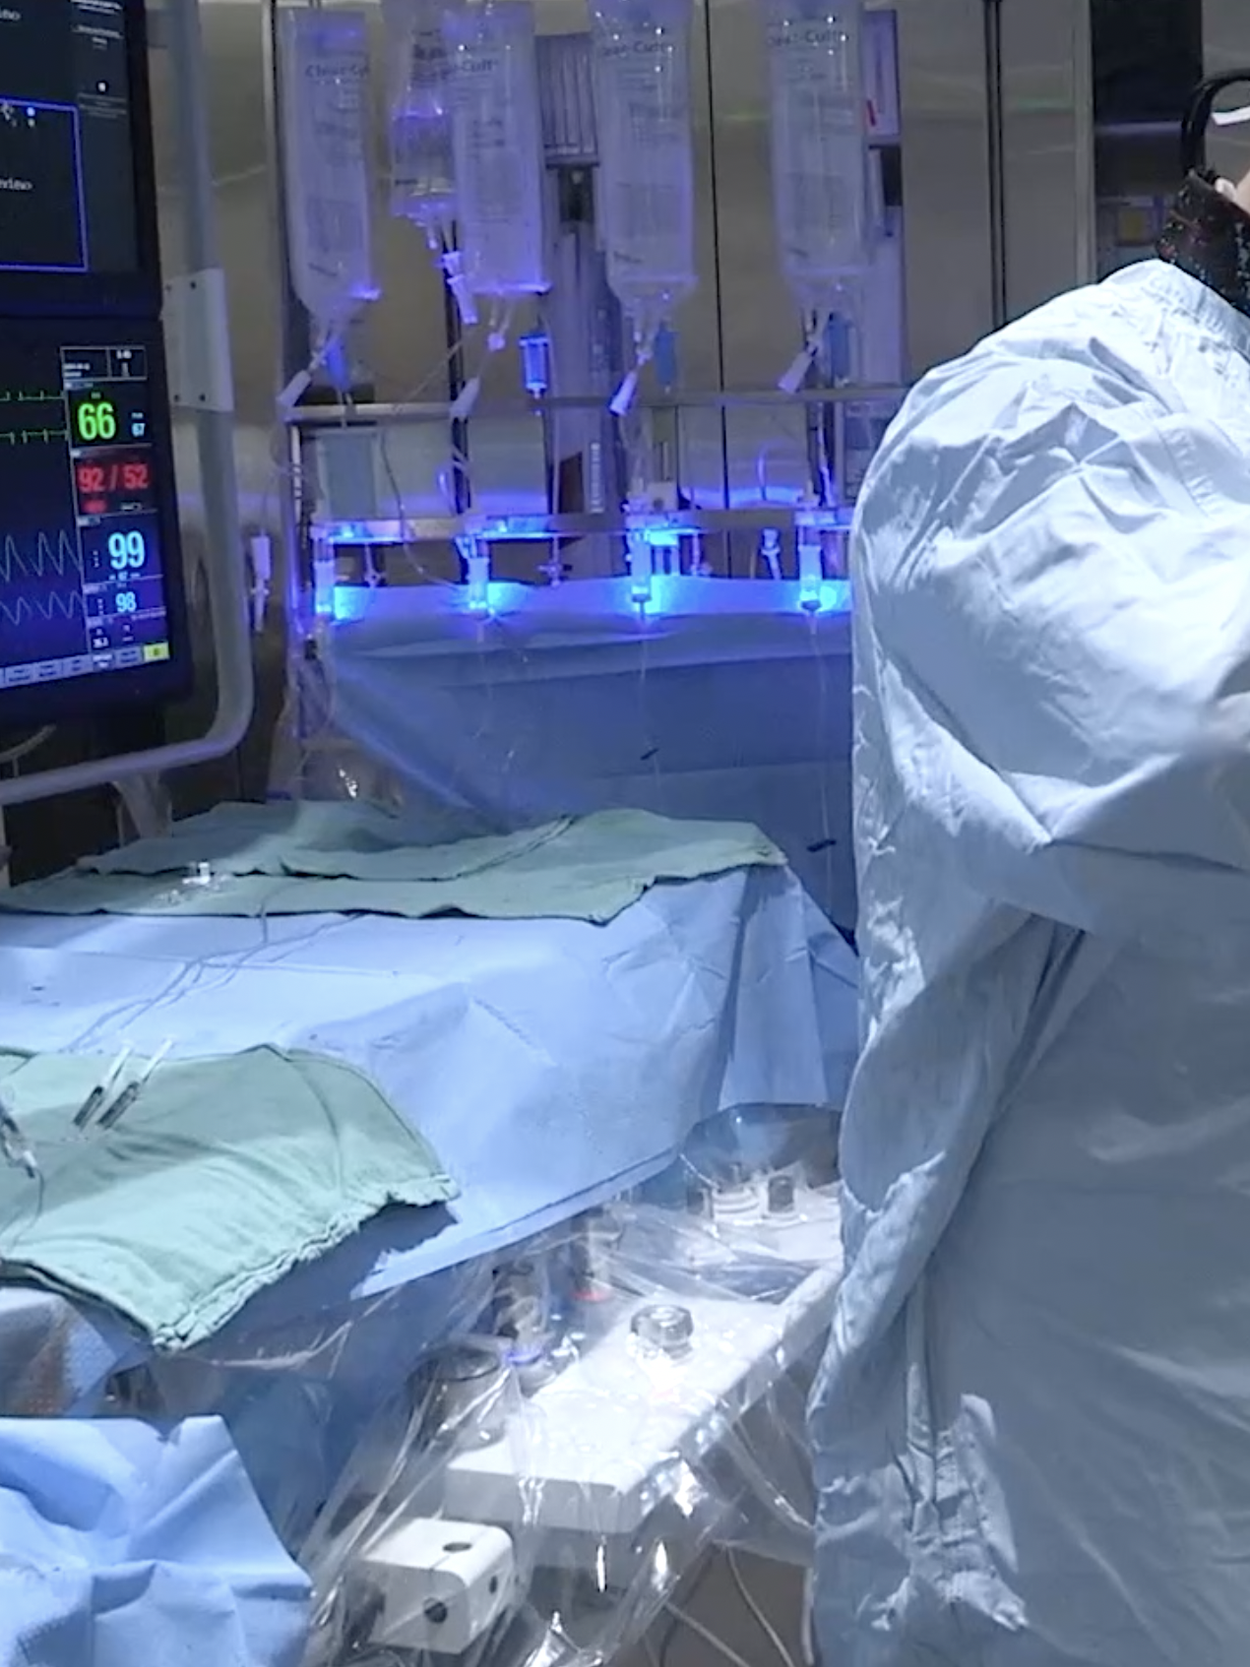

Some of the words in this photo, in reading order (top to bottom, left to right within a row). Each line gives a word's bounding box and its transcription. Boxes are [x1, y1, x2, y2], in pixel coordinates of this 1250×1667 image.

[78, 402, 116, 441] 66
[79, 467, 105, 493] 92
[123, 463, 149, 490] 52
[108, 530, 145, 570] 99
[115, 591, 137, 613] 98
